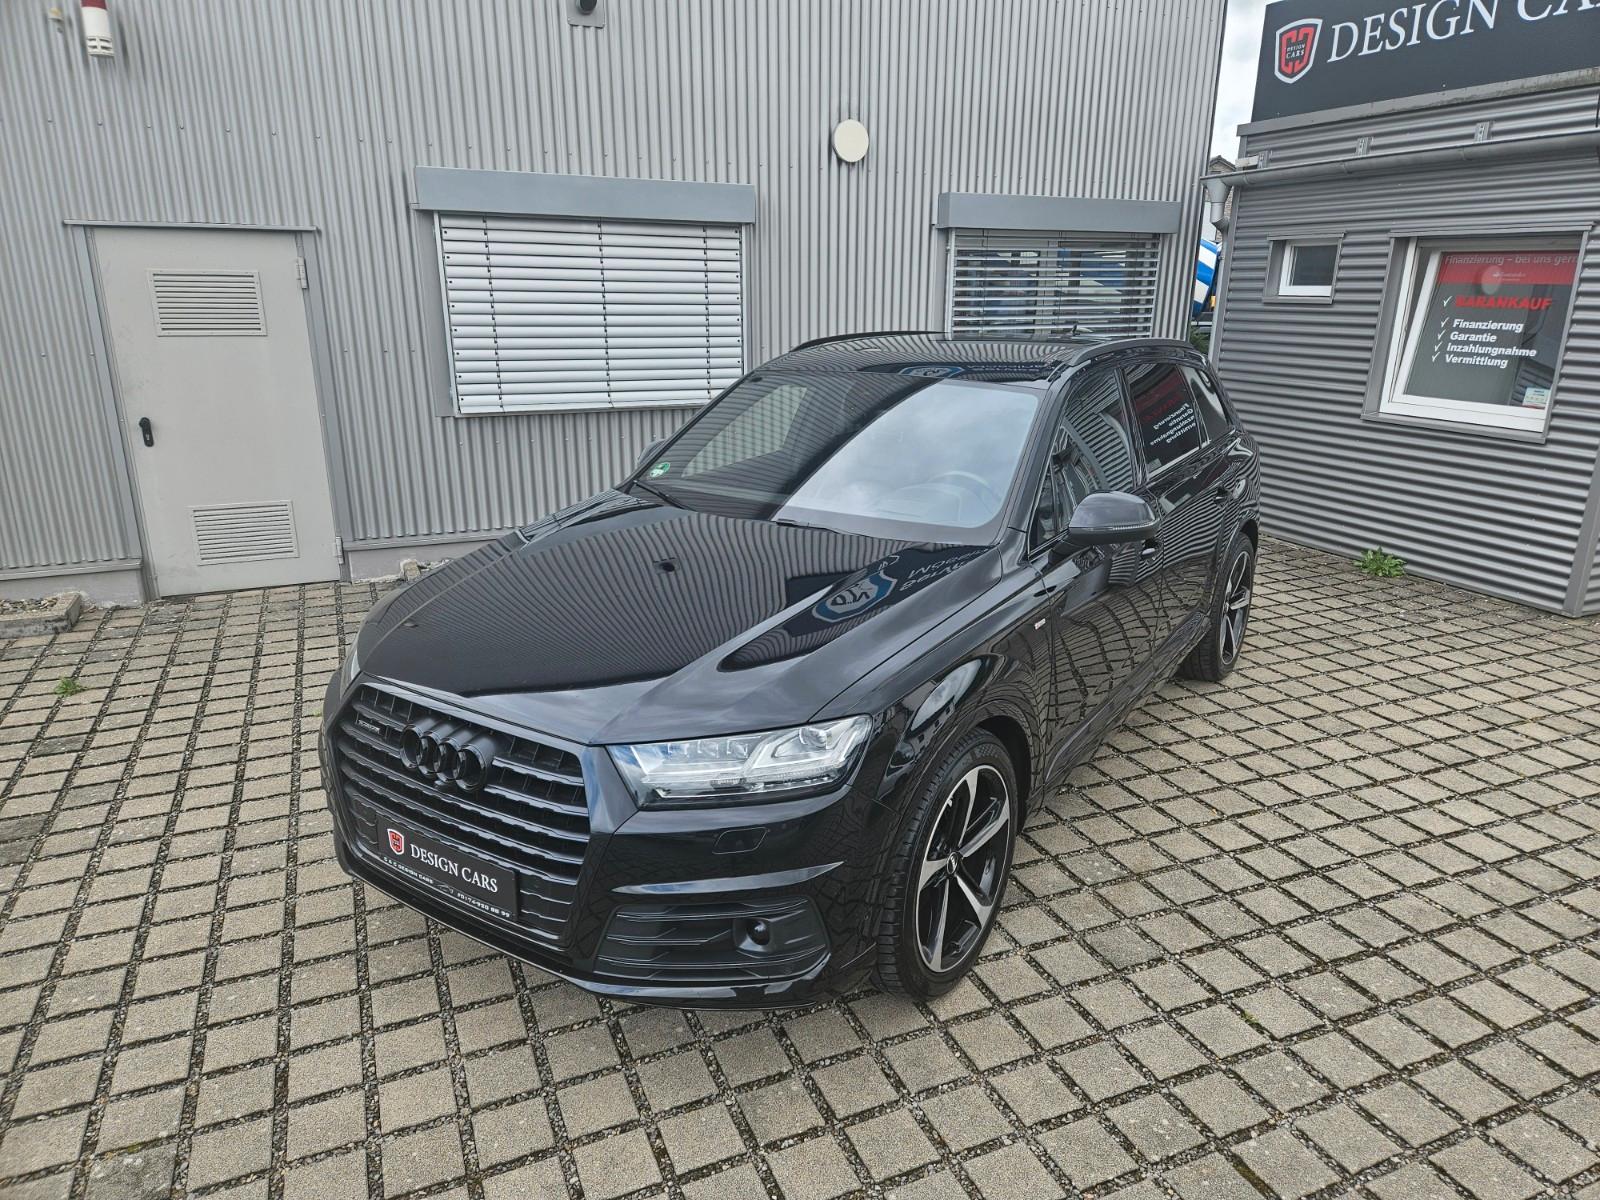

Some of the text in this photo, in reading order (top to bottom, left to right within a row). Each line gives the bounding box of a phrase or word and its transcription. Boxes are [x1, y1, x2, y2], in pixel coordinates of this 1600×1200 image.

[1327, 0, 1498, 63] DESIGN
[1286, 50, 1305, 59] CARS
[1445, 255, 1504, 266] Finanzierung
[1515, 254, 1530, 264] bei
[1534, 256, 1551, 264] uns
[1456, 296, 1552, 310] BARANKAUF
[1453, 318, 1524, 333] Finanzierung
[1450, 331, 1497, 343] Garantie
[1447, 343, 1537, 357] Inzahlungnahme
[1445, 354, 1508, 368] Vermittlung
[410, 843, 498, 893] DESIGN CARS
